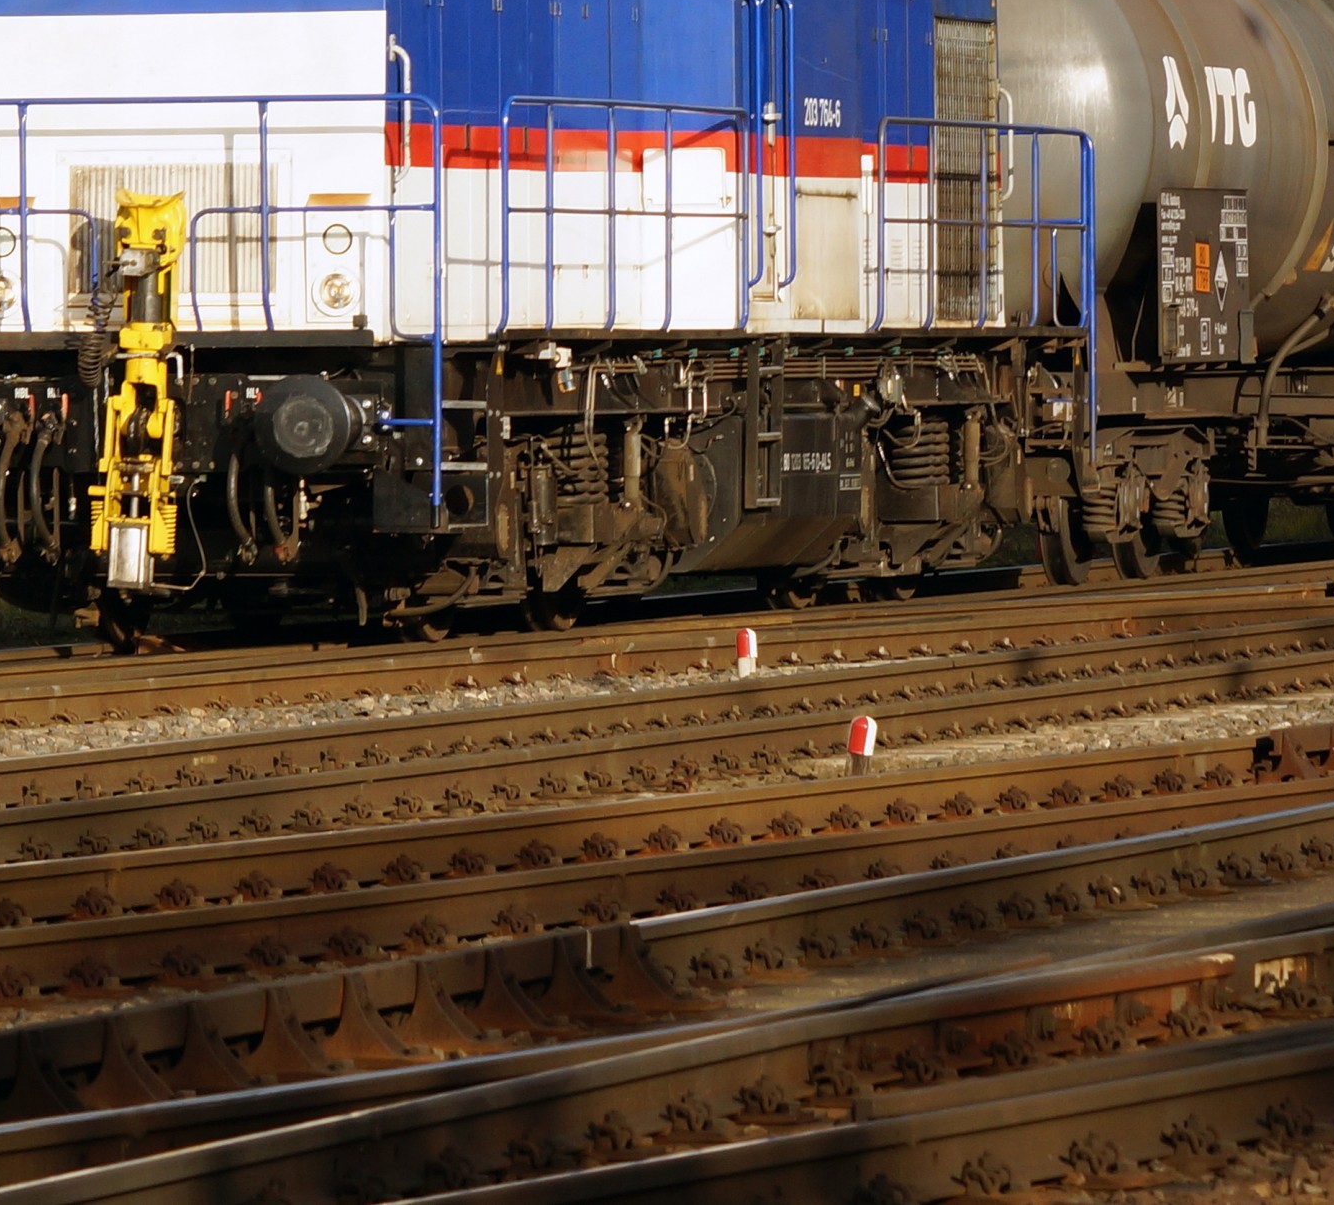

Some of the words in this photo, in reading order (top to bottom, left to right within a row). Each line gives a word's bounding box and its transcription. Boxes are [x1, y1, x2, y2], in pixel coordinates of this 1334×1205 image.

[804, 97, 818, 126] 203
[819, 98, 841, 128] 764-6
[1204, 65, 1257, 148] VTG
